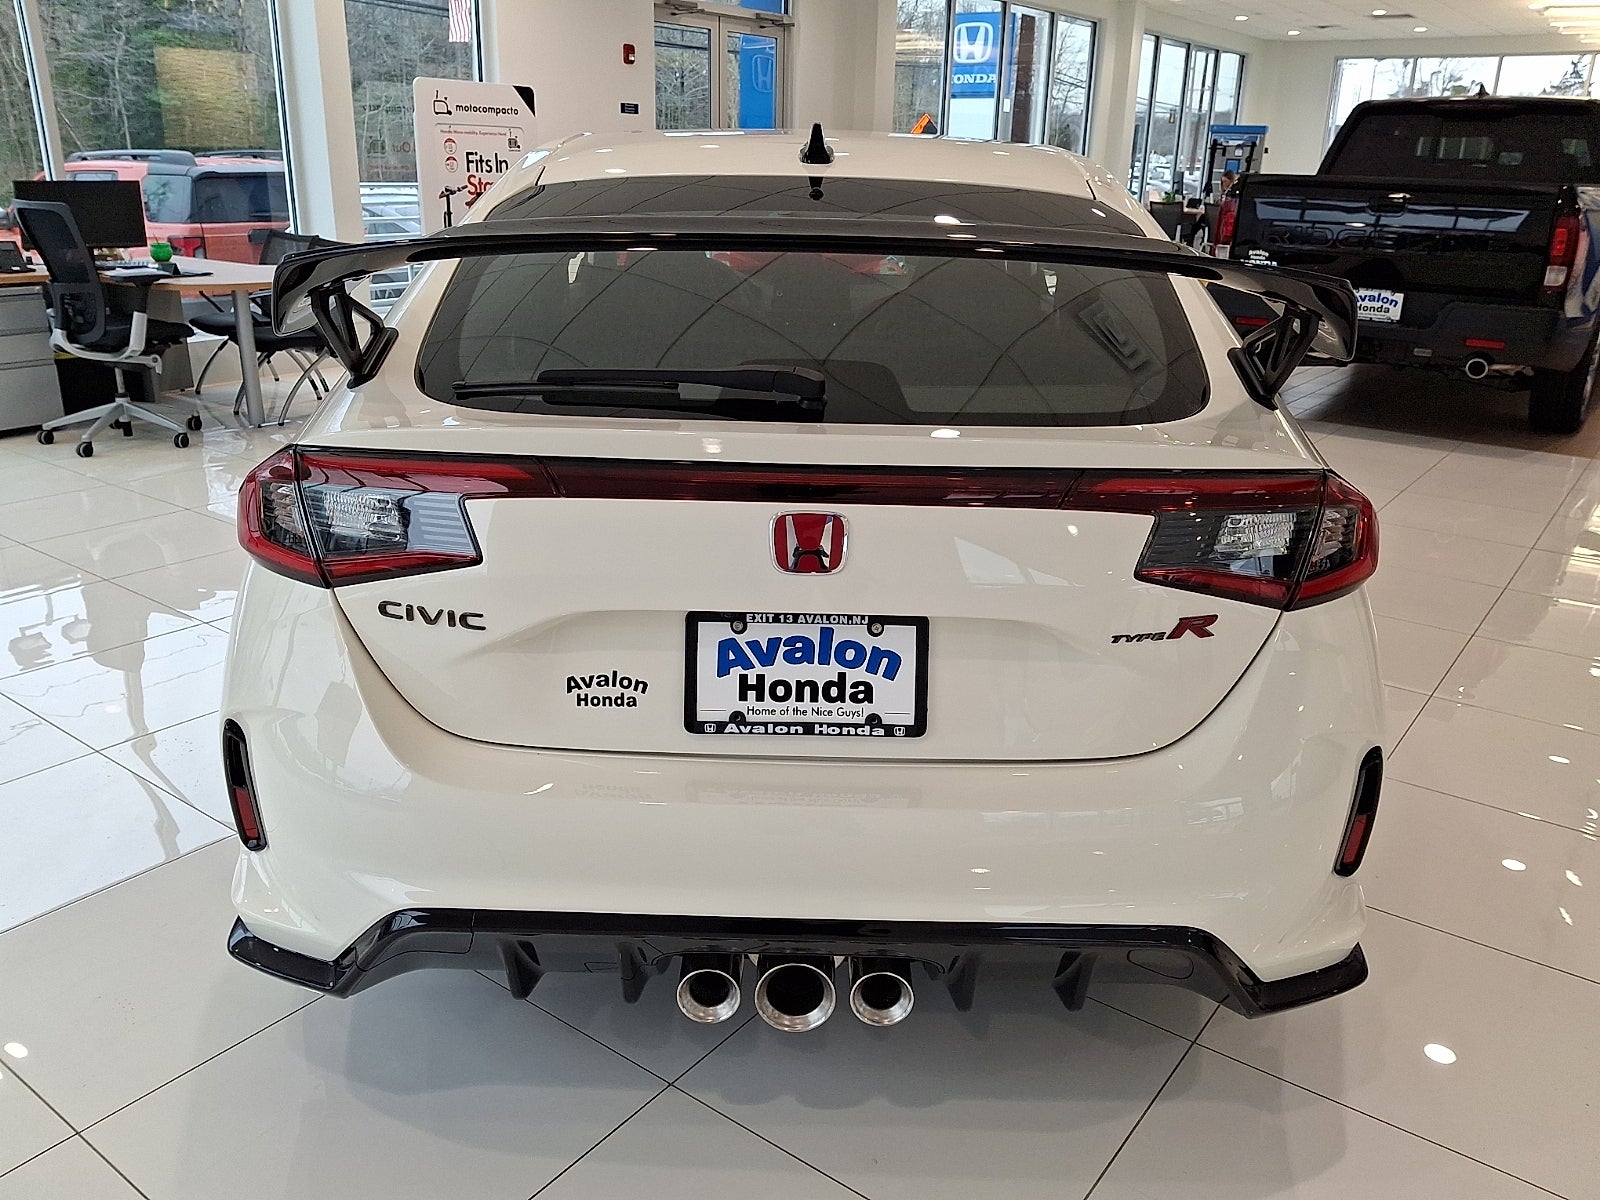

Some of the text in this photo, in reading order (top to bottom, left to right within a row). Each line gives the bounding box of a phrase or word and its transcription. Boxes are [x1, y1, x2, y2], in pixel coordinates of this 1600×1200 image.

[951, 73, 996, 84] ONDA
[465, 151, 493, 174] Fits
[494, 152, 509, 174] In
[1355, 292, 1399, 308] valon
[378, 600, 486, 631] CIVIC
[746, 614, 775, 624] EXIT
[778, 614, 794, 624] 13
[1110, 614, 1219, 644] TYPE R
[716, 626, 903, 682] Avalon
[566, 670, 649, 694] Avalon
[738, 672, 874, 705] Honda
[576, 692, 637, 708] Honda
[746, 705, 864, 719] Home of the Nice Guys!
[724, 723, 885, 736] Avalon Honda
